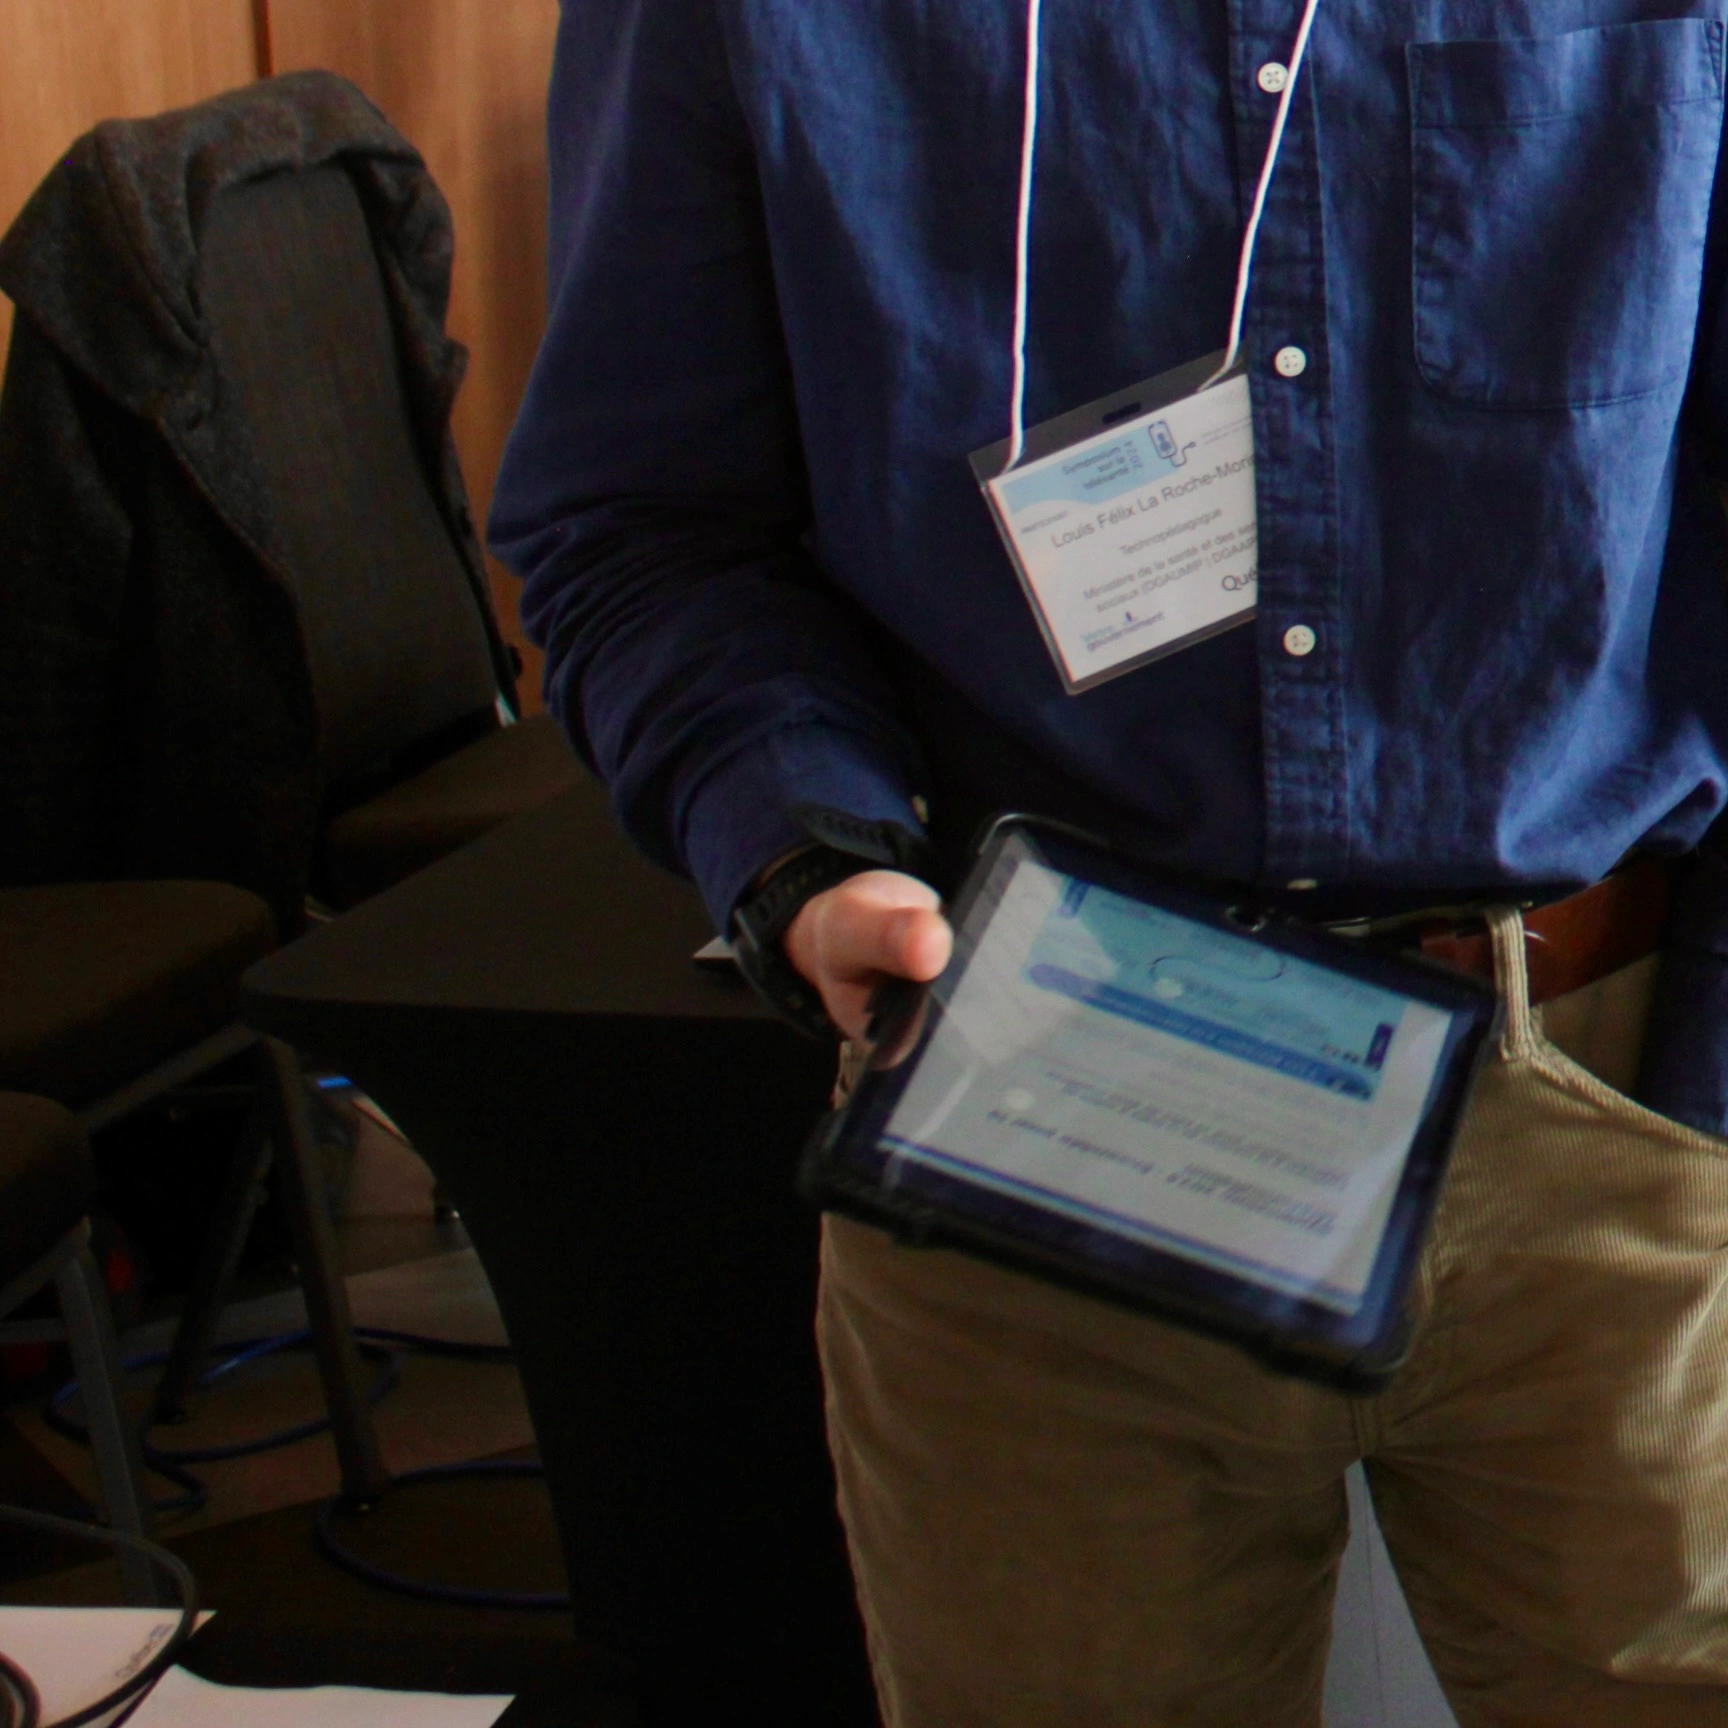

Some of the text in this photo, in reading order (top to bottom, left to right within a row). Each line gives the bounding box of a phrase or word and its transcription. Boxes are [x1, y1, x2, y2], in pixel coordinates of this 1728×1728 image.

[1051, 523, 1096, 548] Louis
[1097, 505, 1136, 529] Félix
[1137, 495, 1160, 513] La
[1083, 573, 1136, 600] Ministère
[1138, 566, 1152, 578] de
[1154, 561, 1165, 571] la
[1167, 547, 1199, 565] santé
[1201, 539, 1213, 551] et
